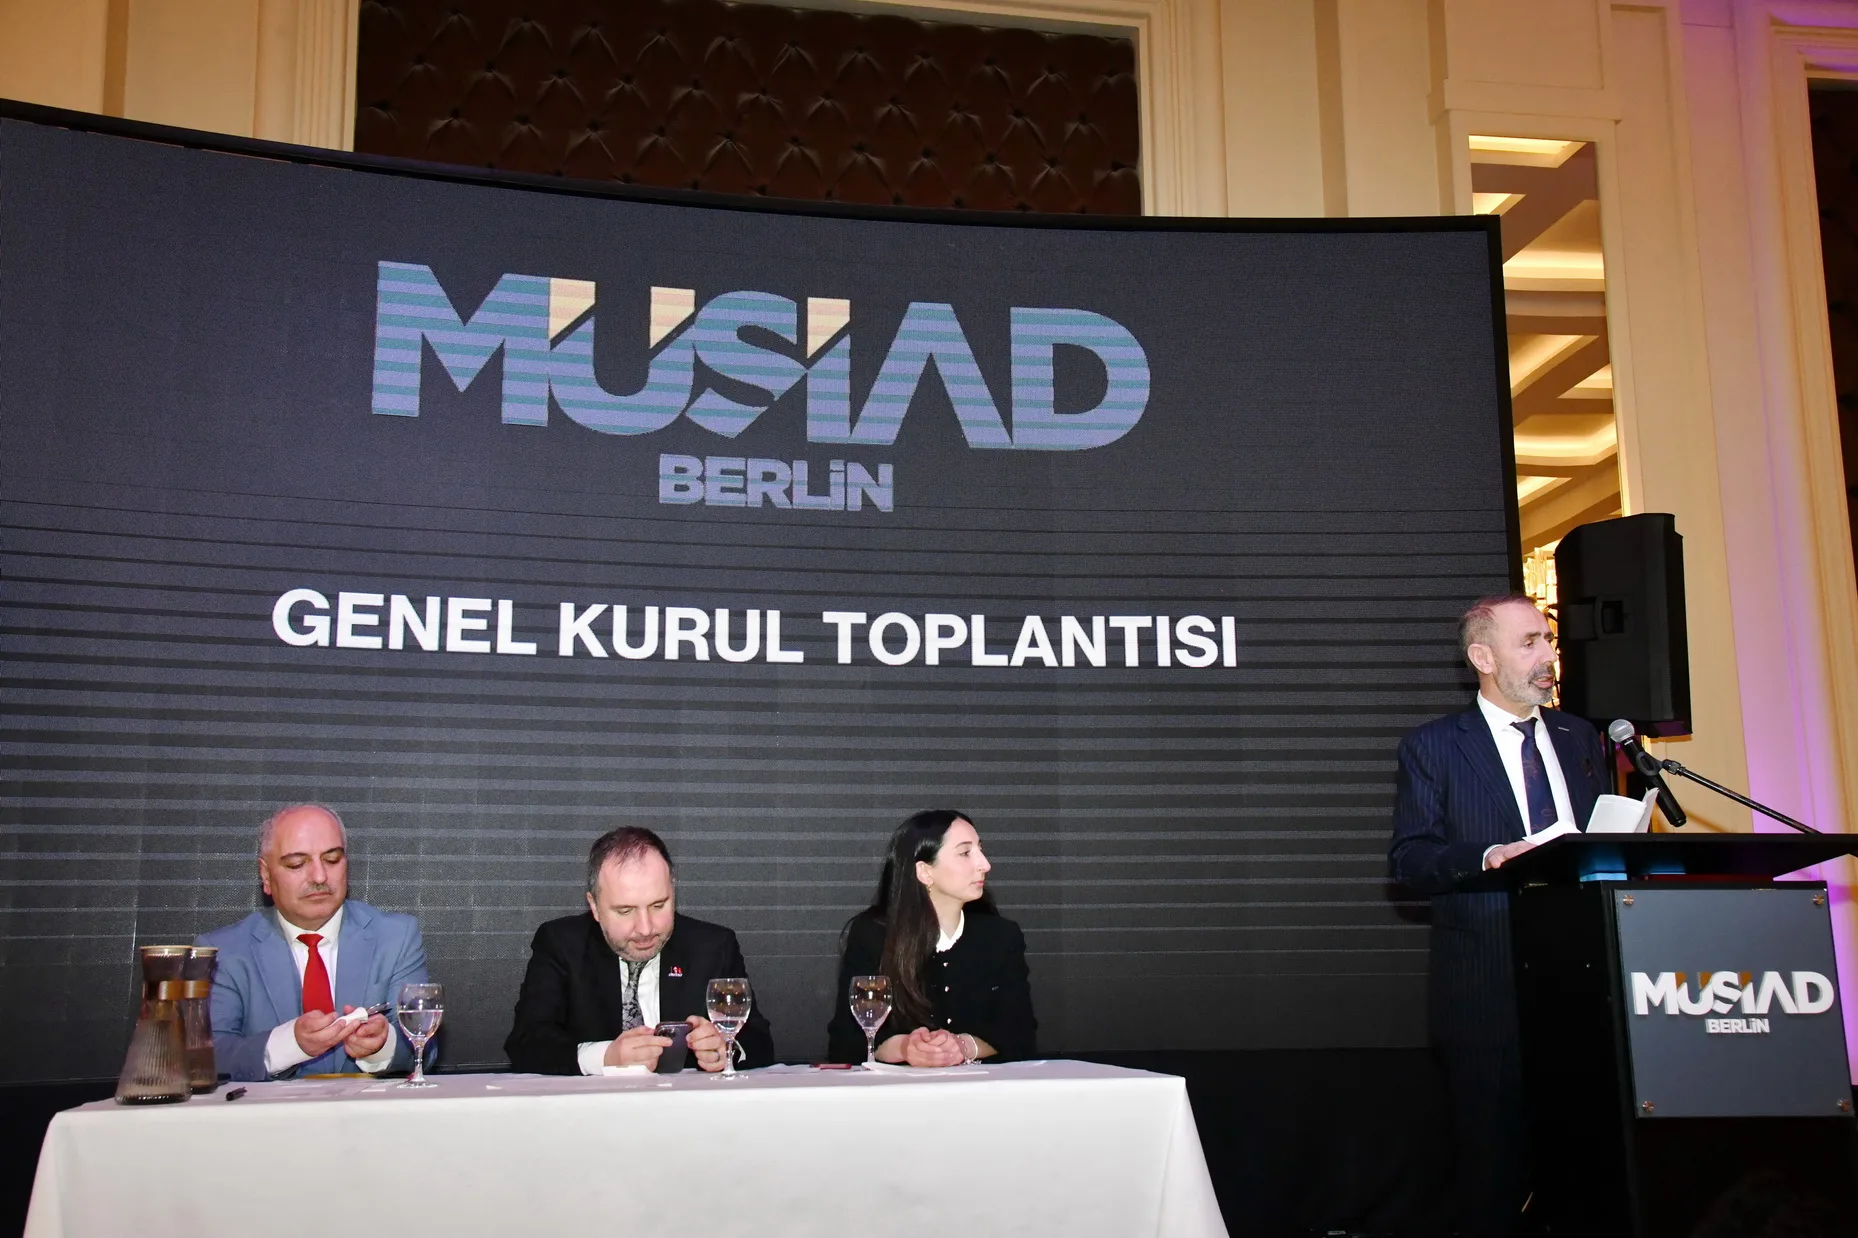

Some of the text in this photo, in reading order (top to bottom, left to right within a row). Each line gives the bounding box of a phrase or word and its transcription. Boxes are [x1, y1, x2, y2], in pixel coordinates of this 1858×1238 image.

[272, 587, 1237, 668] GENEL KURUL TOPLANTISI
